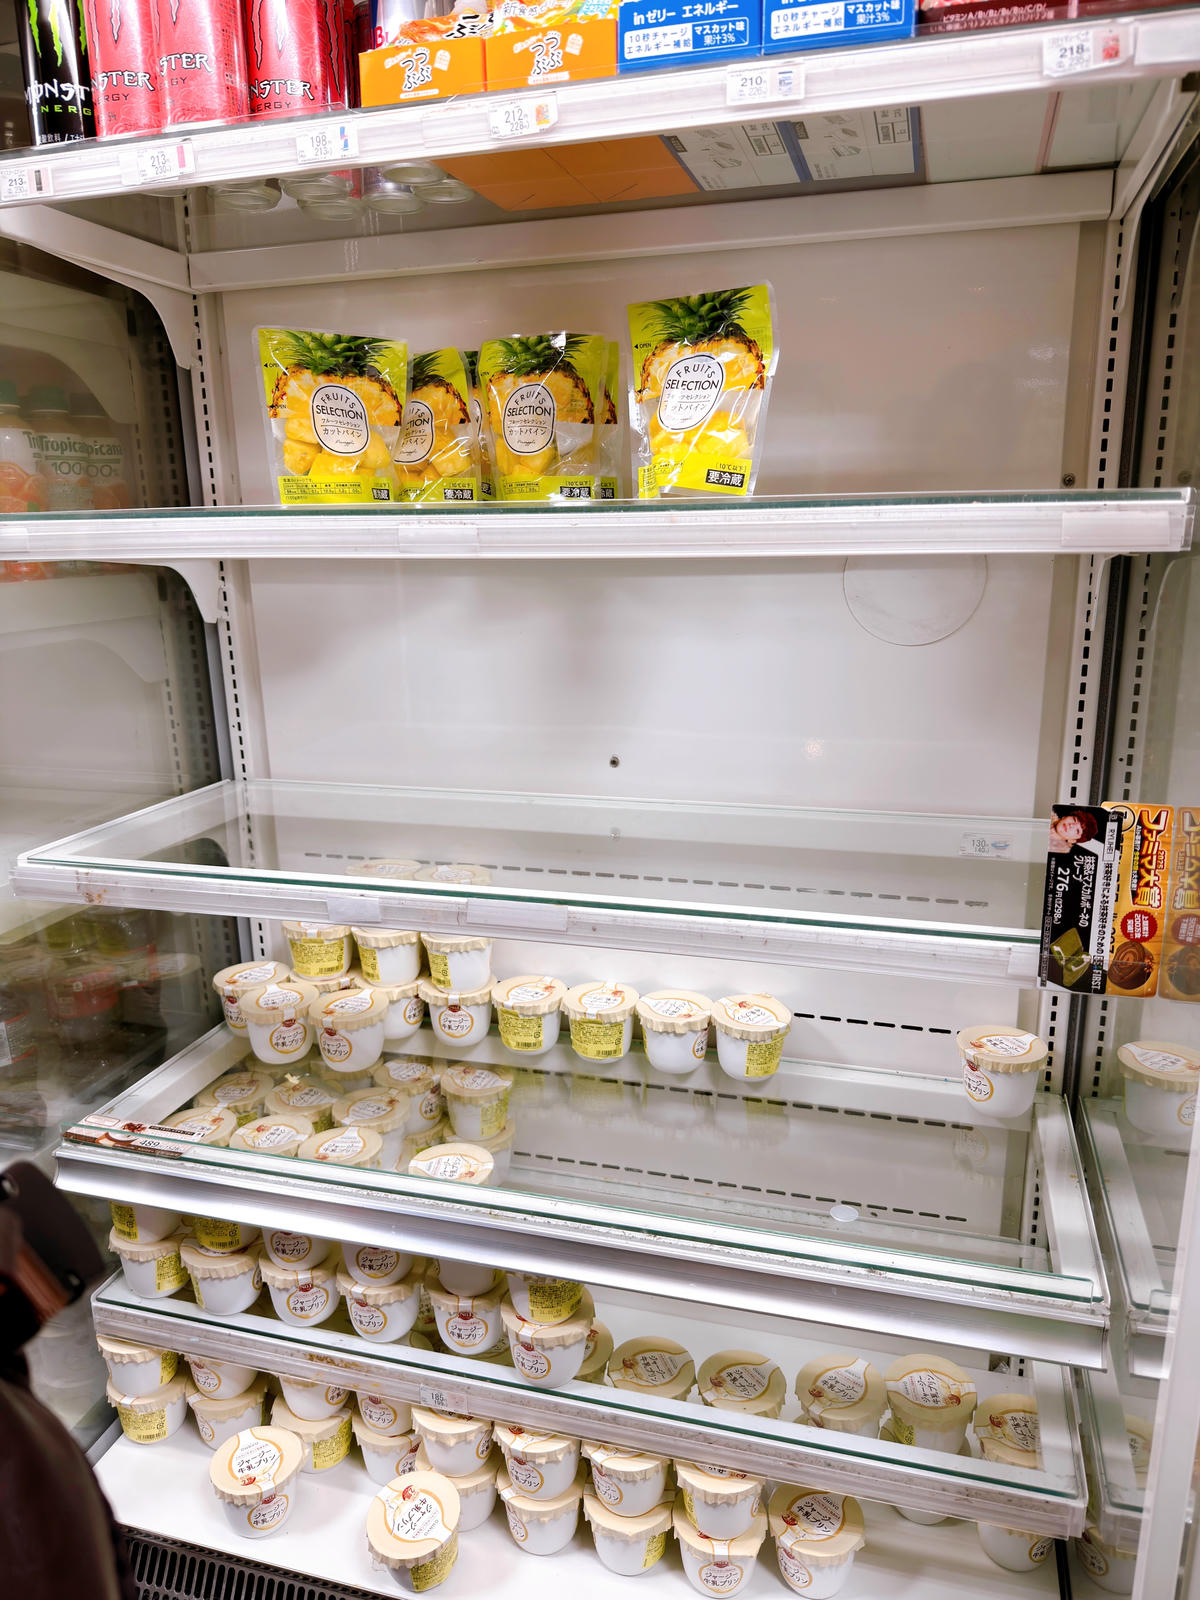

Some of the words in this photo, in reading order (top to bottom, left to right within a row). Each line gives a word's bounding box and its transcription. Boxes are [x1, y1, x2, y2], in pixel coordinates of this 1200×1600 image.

[682, 0, 739, 17] エネルギー
[776, 6, 840, 23] 10秒チャージ
[773, 17, 843, 35] エネルギー補給
[856, 11, 891, 25] 果汁3%
[629, 27, 689, 43] 10秒チャージ
[694, 21, 745, 35] マスカット味
[626, 38, 692, 55] エネルギー補給
[703, 32, 736, 46] 果汁3%
[1059, 44, 1085, 59] 218
[740, 75, 763, 87] 210
[504, 108, 524, 124] 212
[310, 135, 328, 148] 198
[150, 154, 167, 168] 213
[8, 178, 24, 187] 213
[676, 363, 716, 378] FRUITS
[666, 379, 720, 391] SELECTION
[320, 392, 356, 409] FRUITS
[514, 390, 547, 406] FRUITS
[315, 404, 364, 421] SELECTION
[506, 405, 552, 417] SELECTION
[706, 470, 745, 488] 要冷蔵
[1134, 808, 1169, 909] ファミマ大賞
[139, 1139, 161, 1148] 489
[431, 1392, 444, 1401] 185
[237, 1449, 272, 1468] ジャージー
[237, 1454, 276, 1474] 牛乳プリン
[796, 1505, 832, 1533] 牛乳プリン
[803, 1501, 836, 1526] ジャージー
